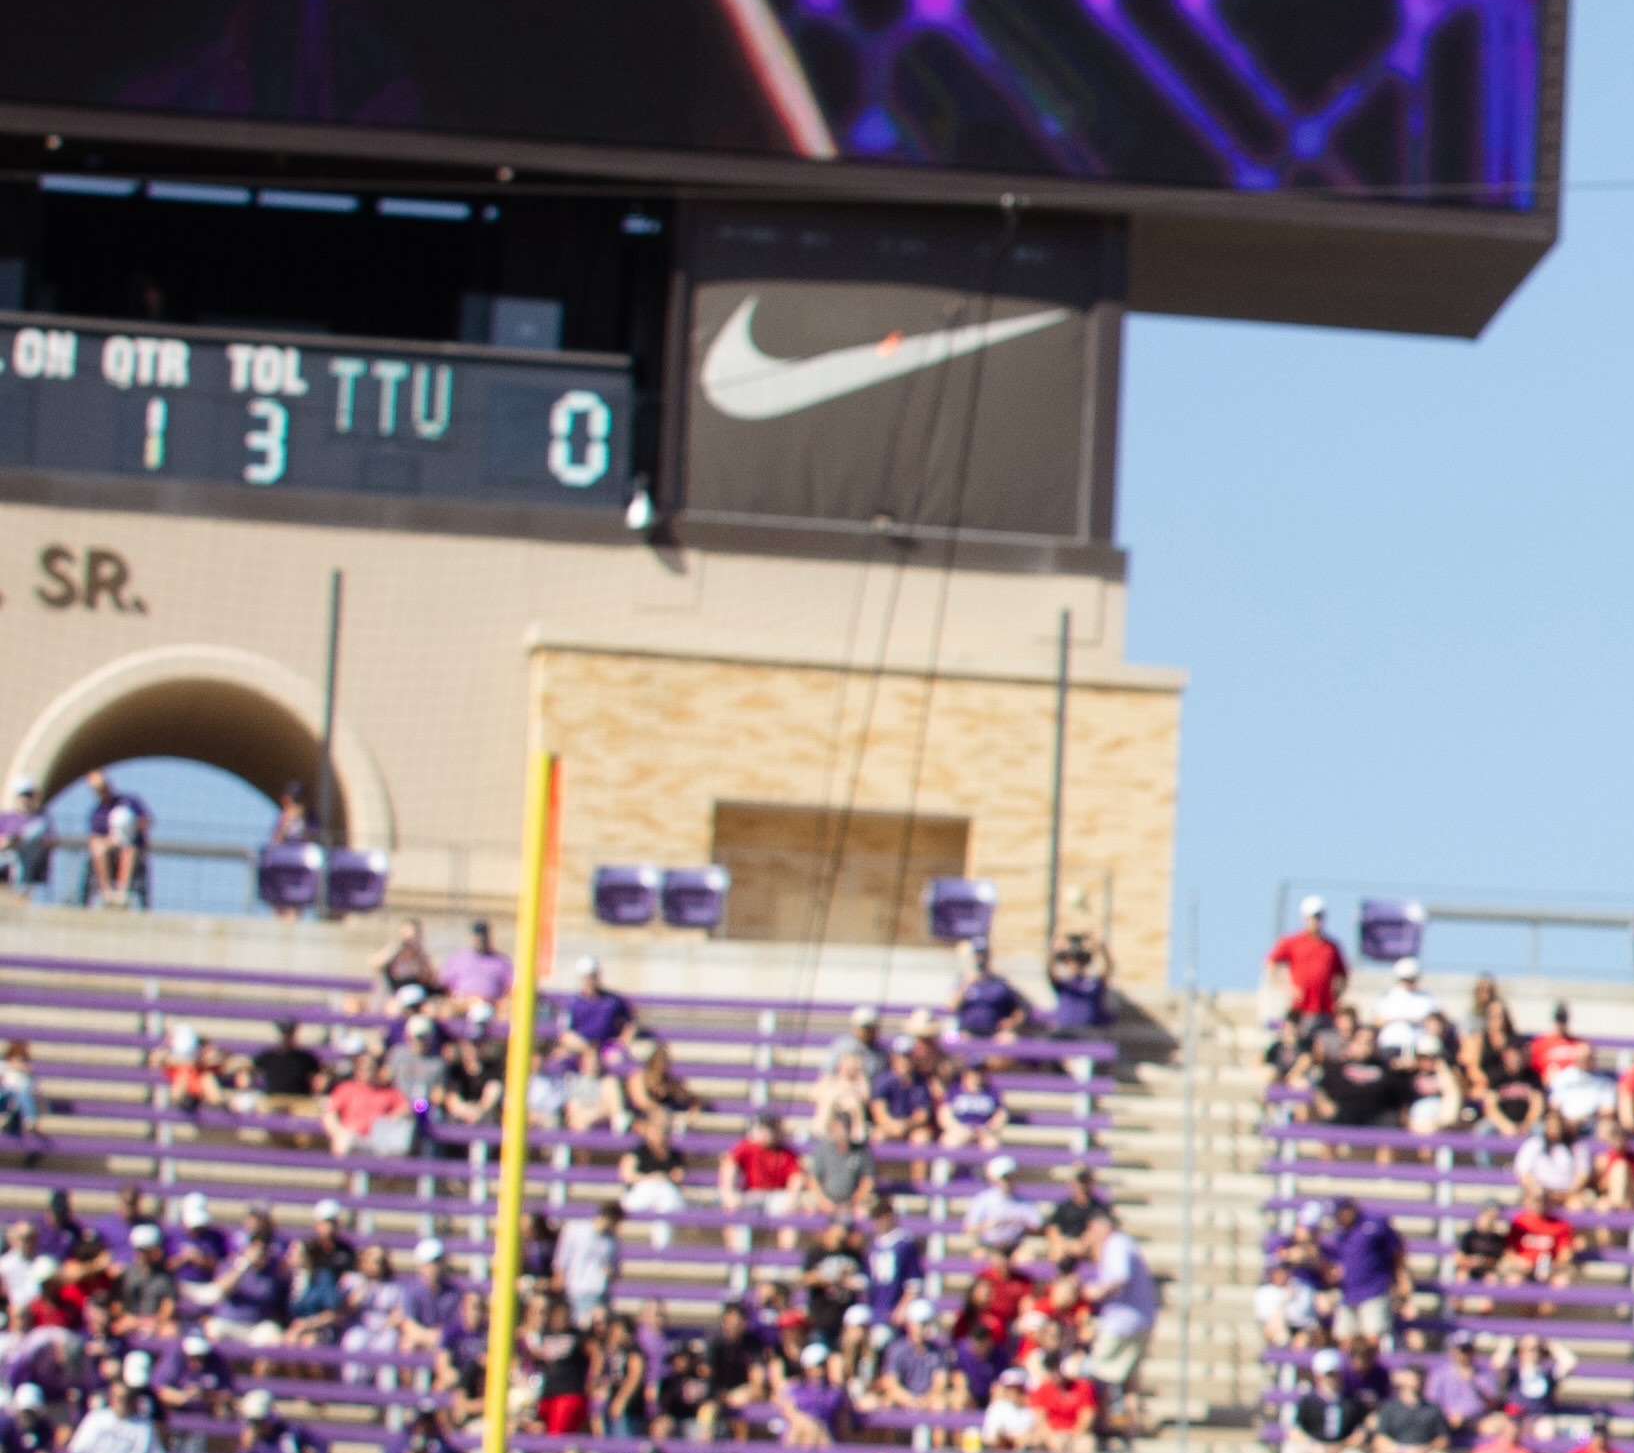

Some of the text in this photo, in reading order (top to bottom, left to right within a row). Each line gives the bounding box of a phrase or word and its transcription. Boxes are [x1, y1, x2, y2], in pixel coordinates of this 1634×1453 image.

[12, 328, 309, 396] ON QTR TOL
[328, 356, 453, 440] TTU
[143, 397, 168, 470] 1
[243, 398, 289, 485] 3
[548, 389, 612, 487] 0
[36, 543, 150, 615] SR.
